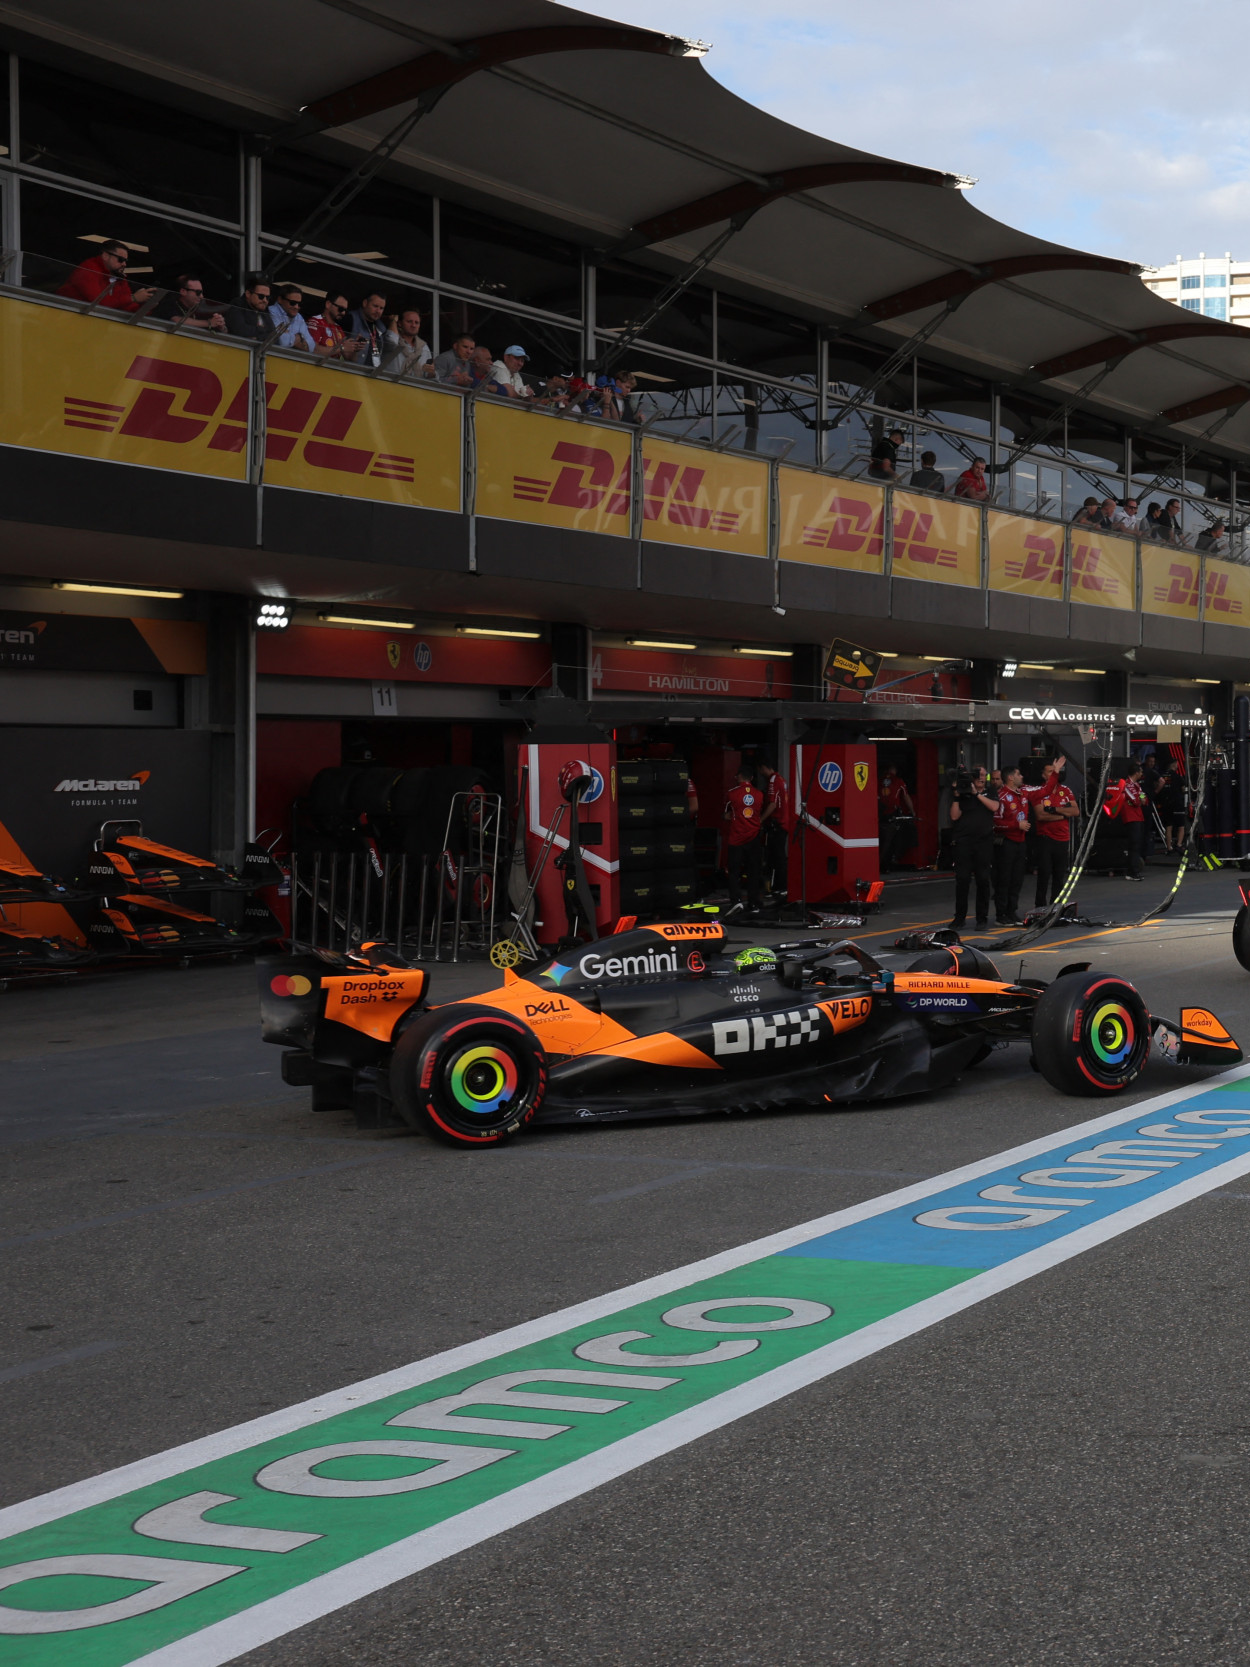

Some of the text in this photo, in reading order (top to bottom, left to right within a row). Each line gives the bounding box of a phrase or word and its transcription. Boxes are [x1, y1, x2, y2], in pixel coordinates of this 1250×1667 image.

[119, 355, 375, 475] DHL
[548, 441, 713, 529] DHL
[826, 496, 939, 564] DHL
[1021, 534, 1106, 590] DHL
[1166, 563, 1233, 614] DHL
[11, 653, 35, 661] TEAM
[416, 644, 430, 670] hp
[834, 657, 860, 673] brembo
[648, 675, 729, 692] HAMILTON
[376, 687, 393, 707] 11
[1147, 701, 1183, 713] TSUNODA
[1063, 713, 1116, 721] LOGISTICS
[54, 779, 141, 792] McLaren
[822, 761, 840, 792] hp
[71, 799, 107, 807] FORMULA
[118, 798, 138, 806] TEAM
[662, 923, 720, 941] allwyn
[579, 945, 678, 980] Gemini
[759, 963, 776, 971] okta
[343, 980, 406, 992] Dropbox
[908, 981, 971, 989] RICHARD MILLE
[341, 994, 377, 1005] Dash
[524, 999, 570, 1017] DELL
[919, 998, 968, 1007] DP WORLD
[825, 998, 870, 1020] VELO
[529, 1013, 573, 1027] Technologies
[1072, 1009, 1084, 1042] PIRELLI
[1186, 1018, 1213, 1029] workday
[712, 1006, 821, 1056] OKX
[420, 1050, 438, 1089] PIRELLI
[0, 1296, 836, 1636] aramco
